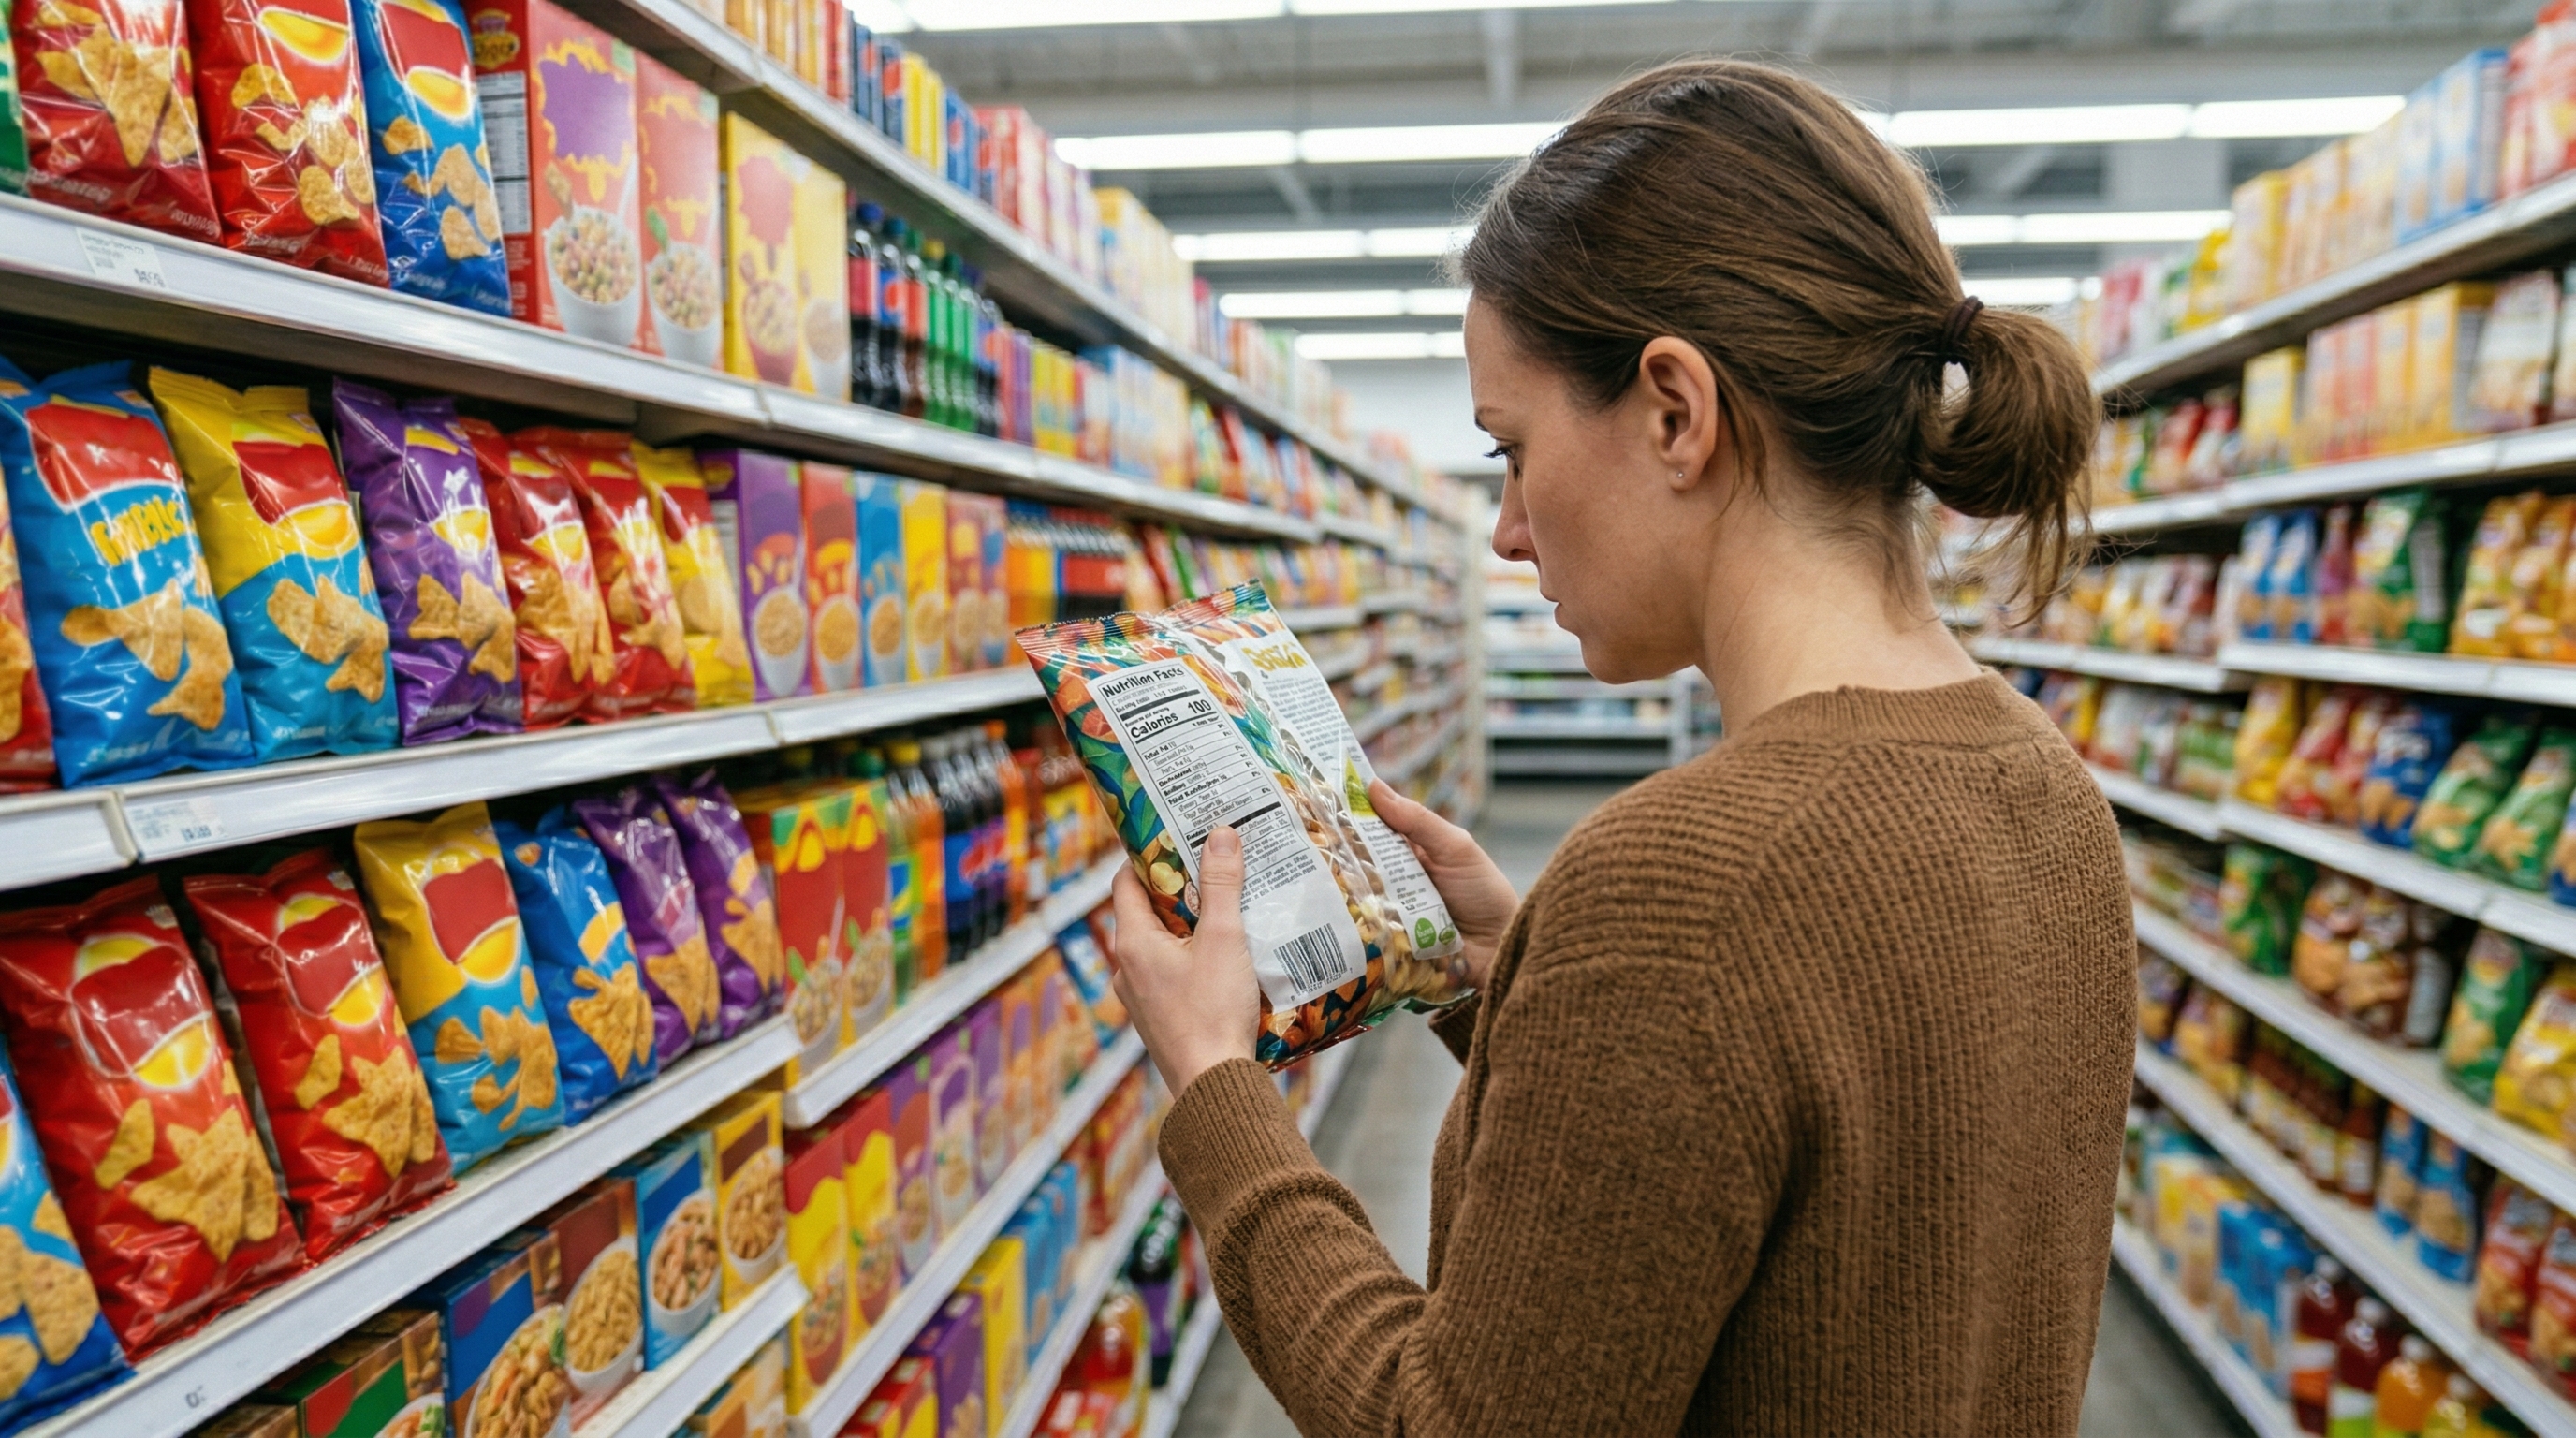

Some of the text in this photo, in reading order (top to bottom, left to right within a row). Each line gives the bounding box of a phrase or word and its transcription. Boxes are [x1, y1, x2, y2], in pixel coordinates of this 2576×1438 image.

[1153, 668, 1184, 681] Facts
[1131, 712, 1178, 738] Calories
[1187, 699, 1212, 714] 100
